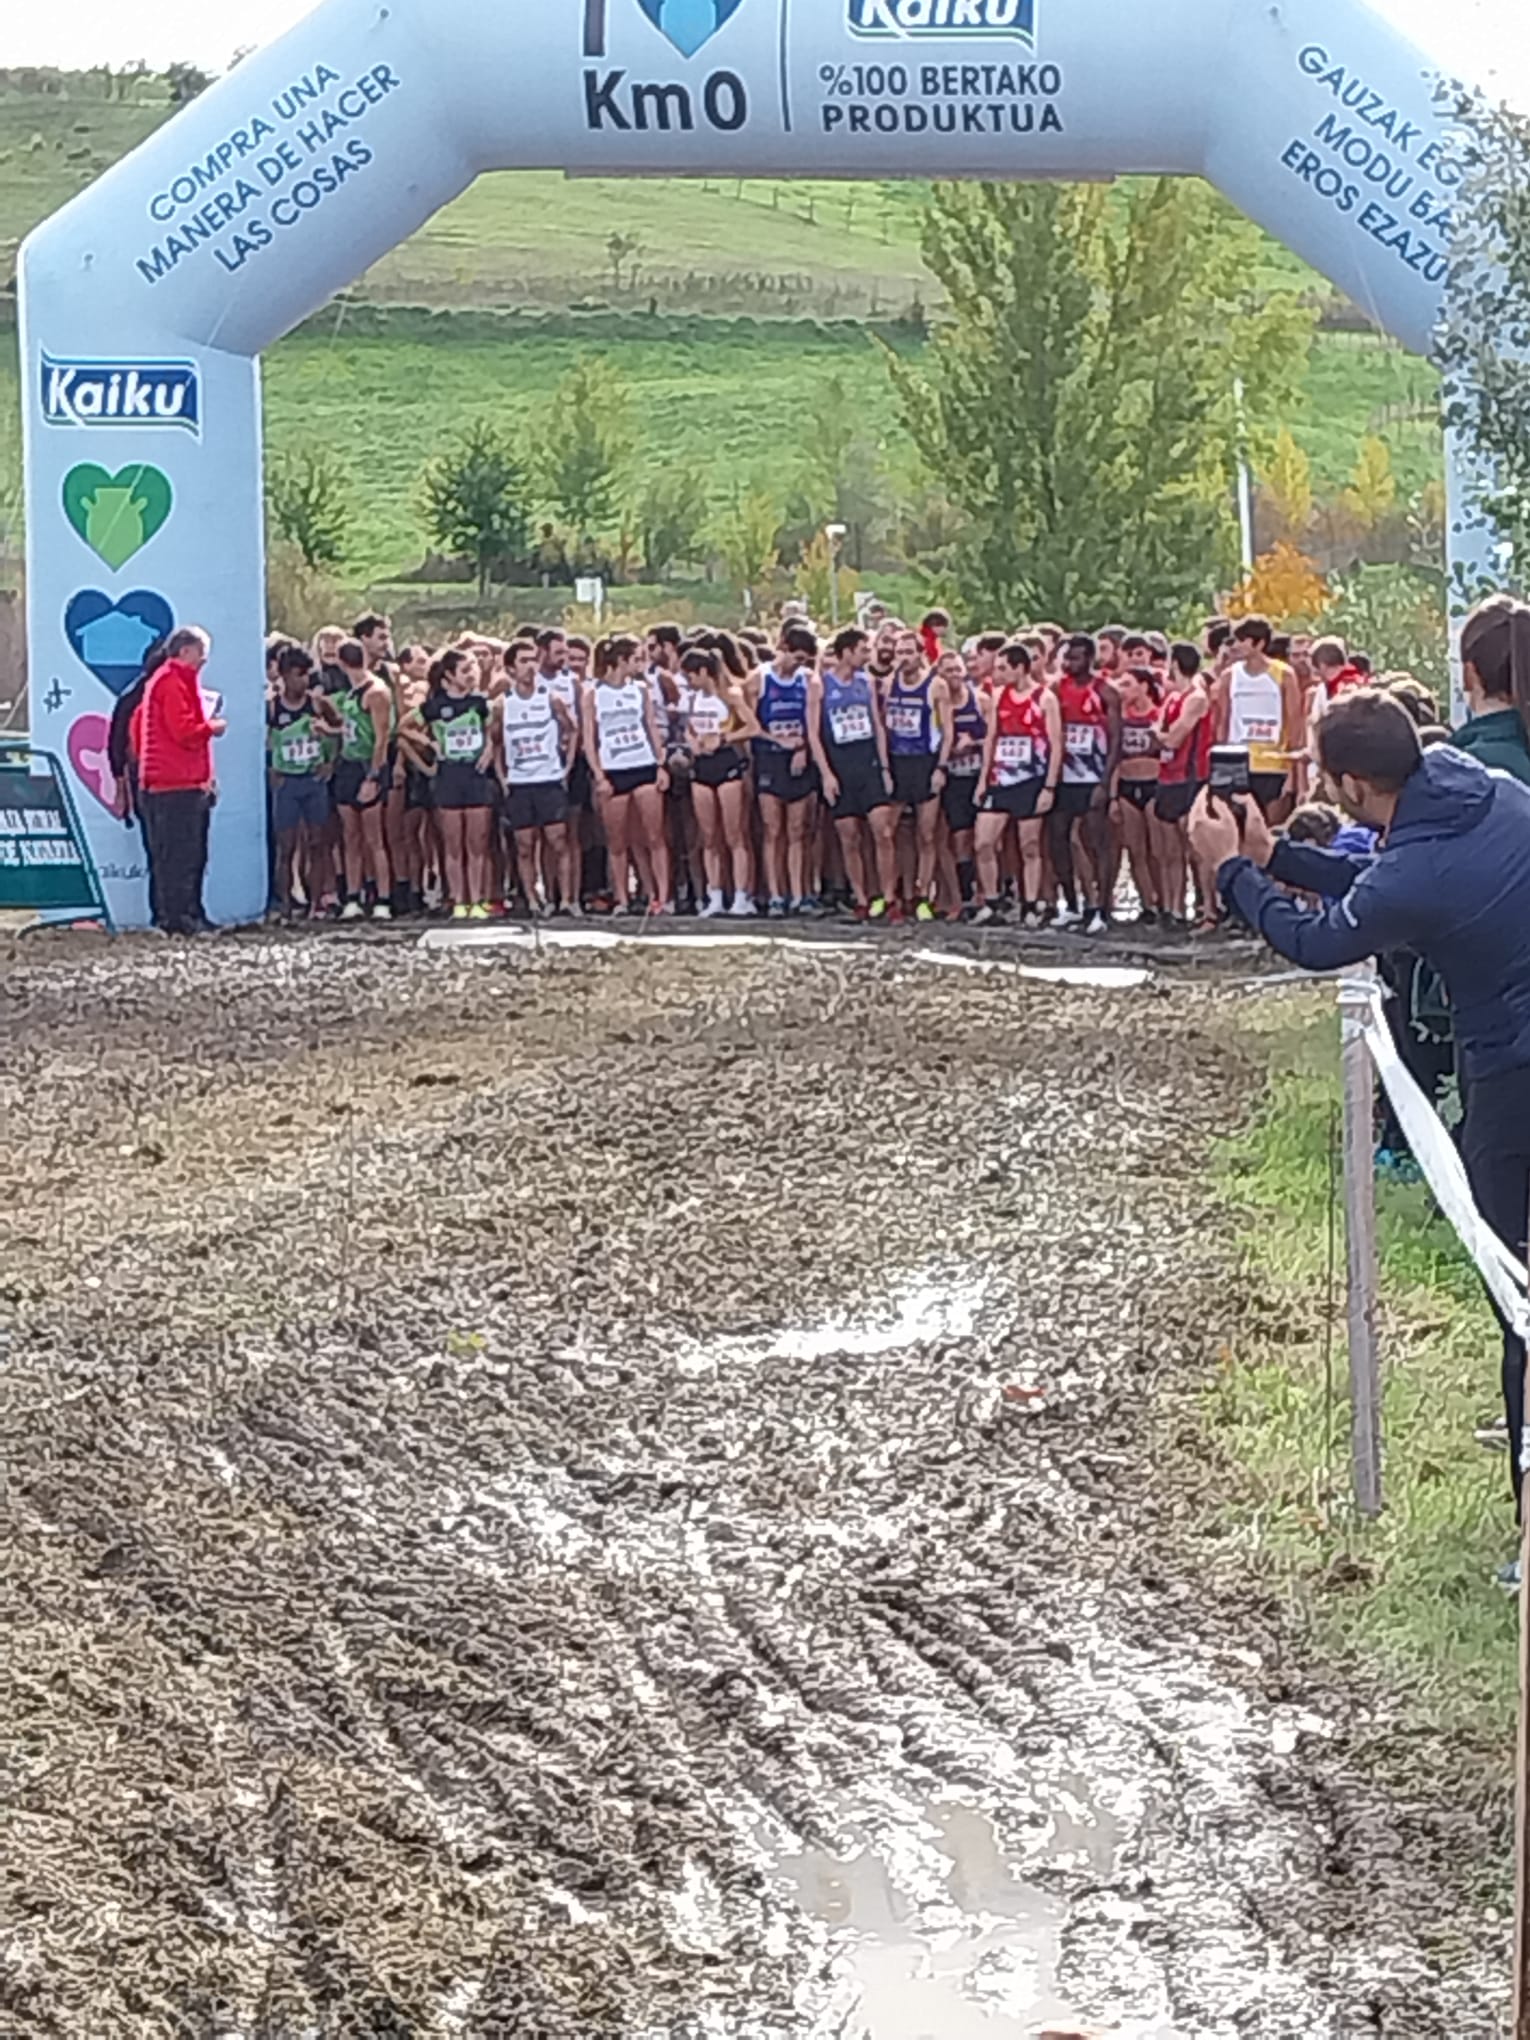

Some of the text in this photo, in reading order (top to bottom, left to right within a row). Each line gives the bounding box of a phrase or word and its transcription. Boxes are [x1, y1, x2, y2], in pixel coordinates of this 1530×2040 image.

[819, 64, 1061, 96] %100 BERTAKO
[822, 103, 1064, 132] PRODUKTUA
[1298, 46, 1422, 152] GAUZAK
[136, 64, 401, 284] MANERA DE HACER
[150, 64, 340, 222] COMPRA UNA
[1313, 113, 1414, 199] MODU
[214, 140, 374, 272] LAS COSAS
[1280, 140, 1449, 282] EROS EZAZU
[48, 368, 187, 425] Kaiku
